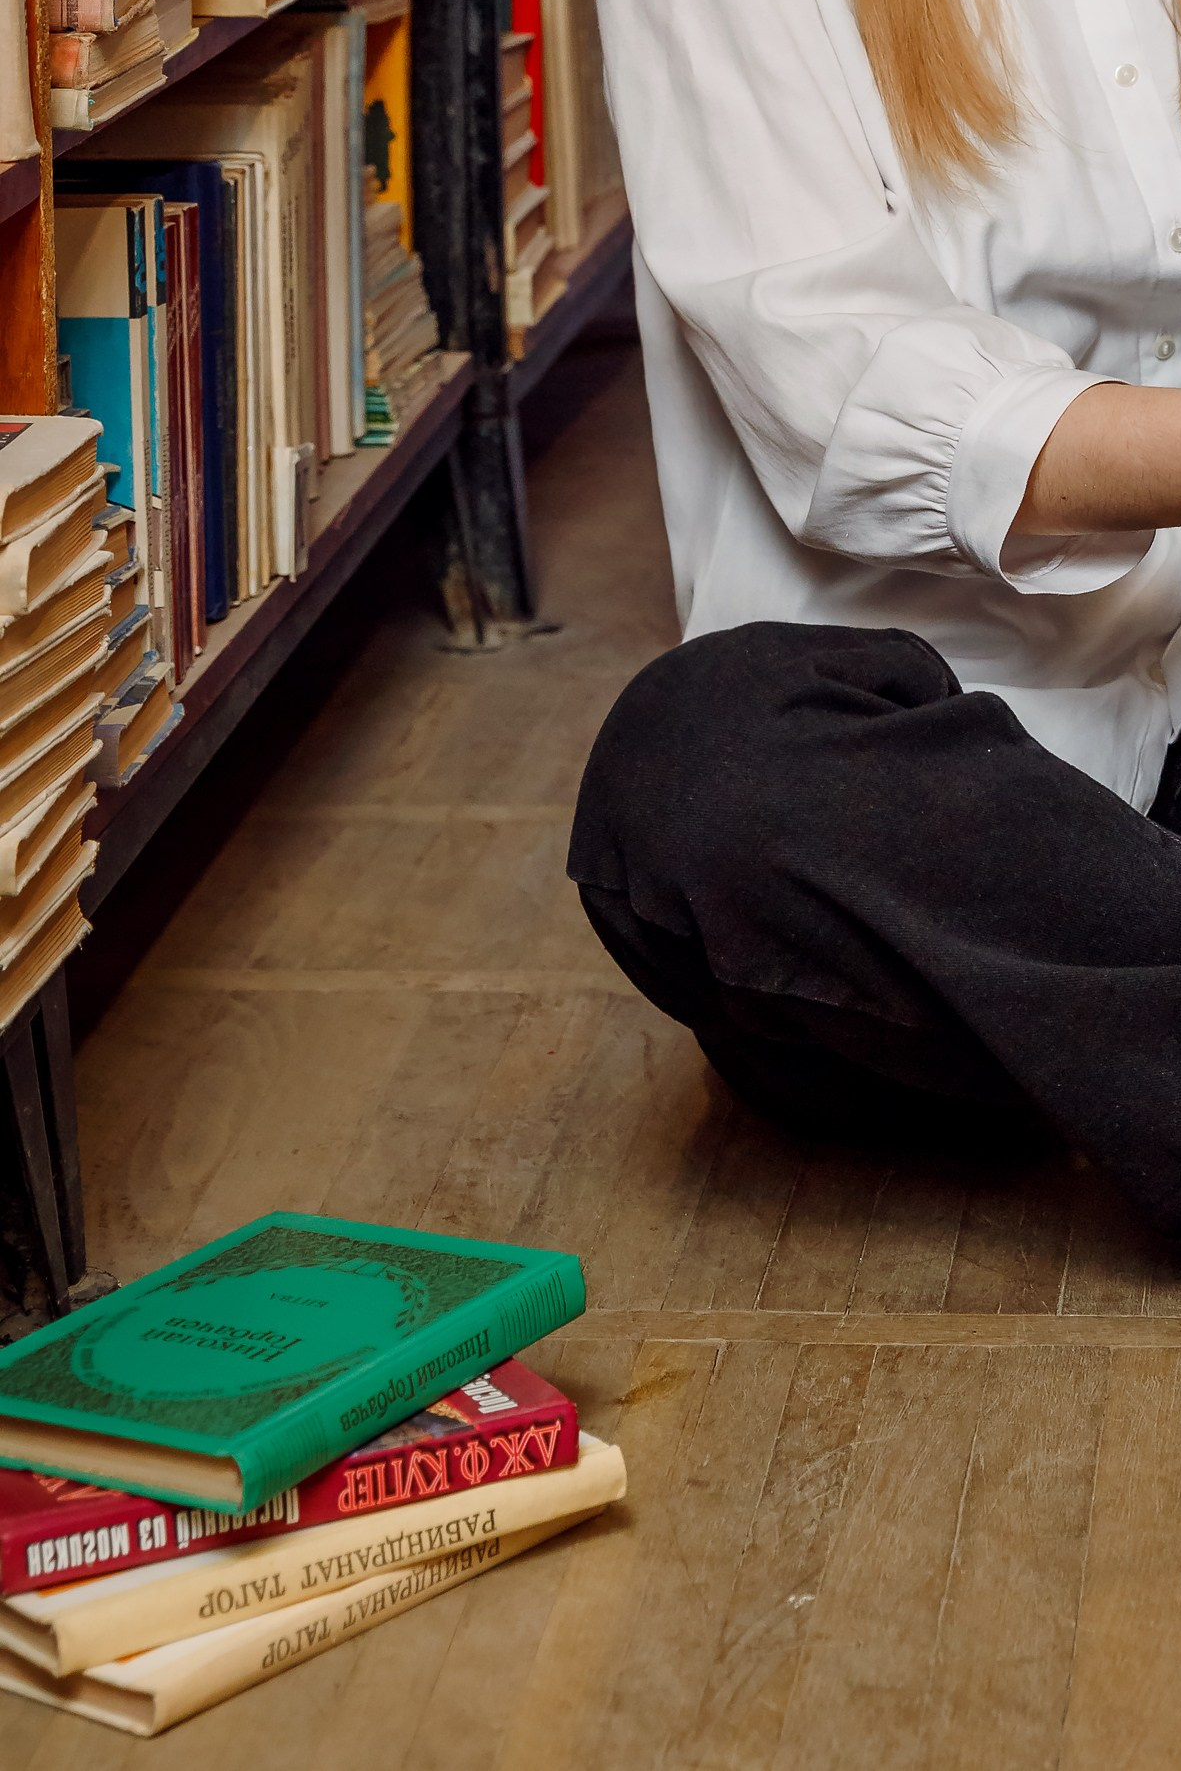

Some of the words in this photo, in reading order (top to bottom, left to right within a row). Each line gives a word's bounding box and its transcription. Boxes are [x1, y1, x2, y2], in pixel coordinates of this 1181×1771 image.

[269, 1292, 329, 1308] БИТВА
[141, 1328, 284, 1363] Николай
[164, 1317, 303, 1350] Горбачев
[414, 1329, 492, 1390] Николай
[339, 1373, 415, 1433] Горбачев
[337, 1449, 450, 1513] КУПЕР
[26, 1522, 130, 1578] могикан
[137, 1514, 168, 1552] из
[300, 1508, 498, 1590] РАБИНДРАНАТ
[198, 1573, 287, 1619] ТАГОР
[342, 1537, 501, 1630] РАБИНДРАНАТ
[261, 1616, 332, 1670] ТАГОР
